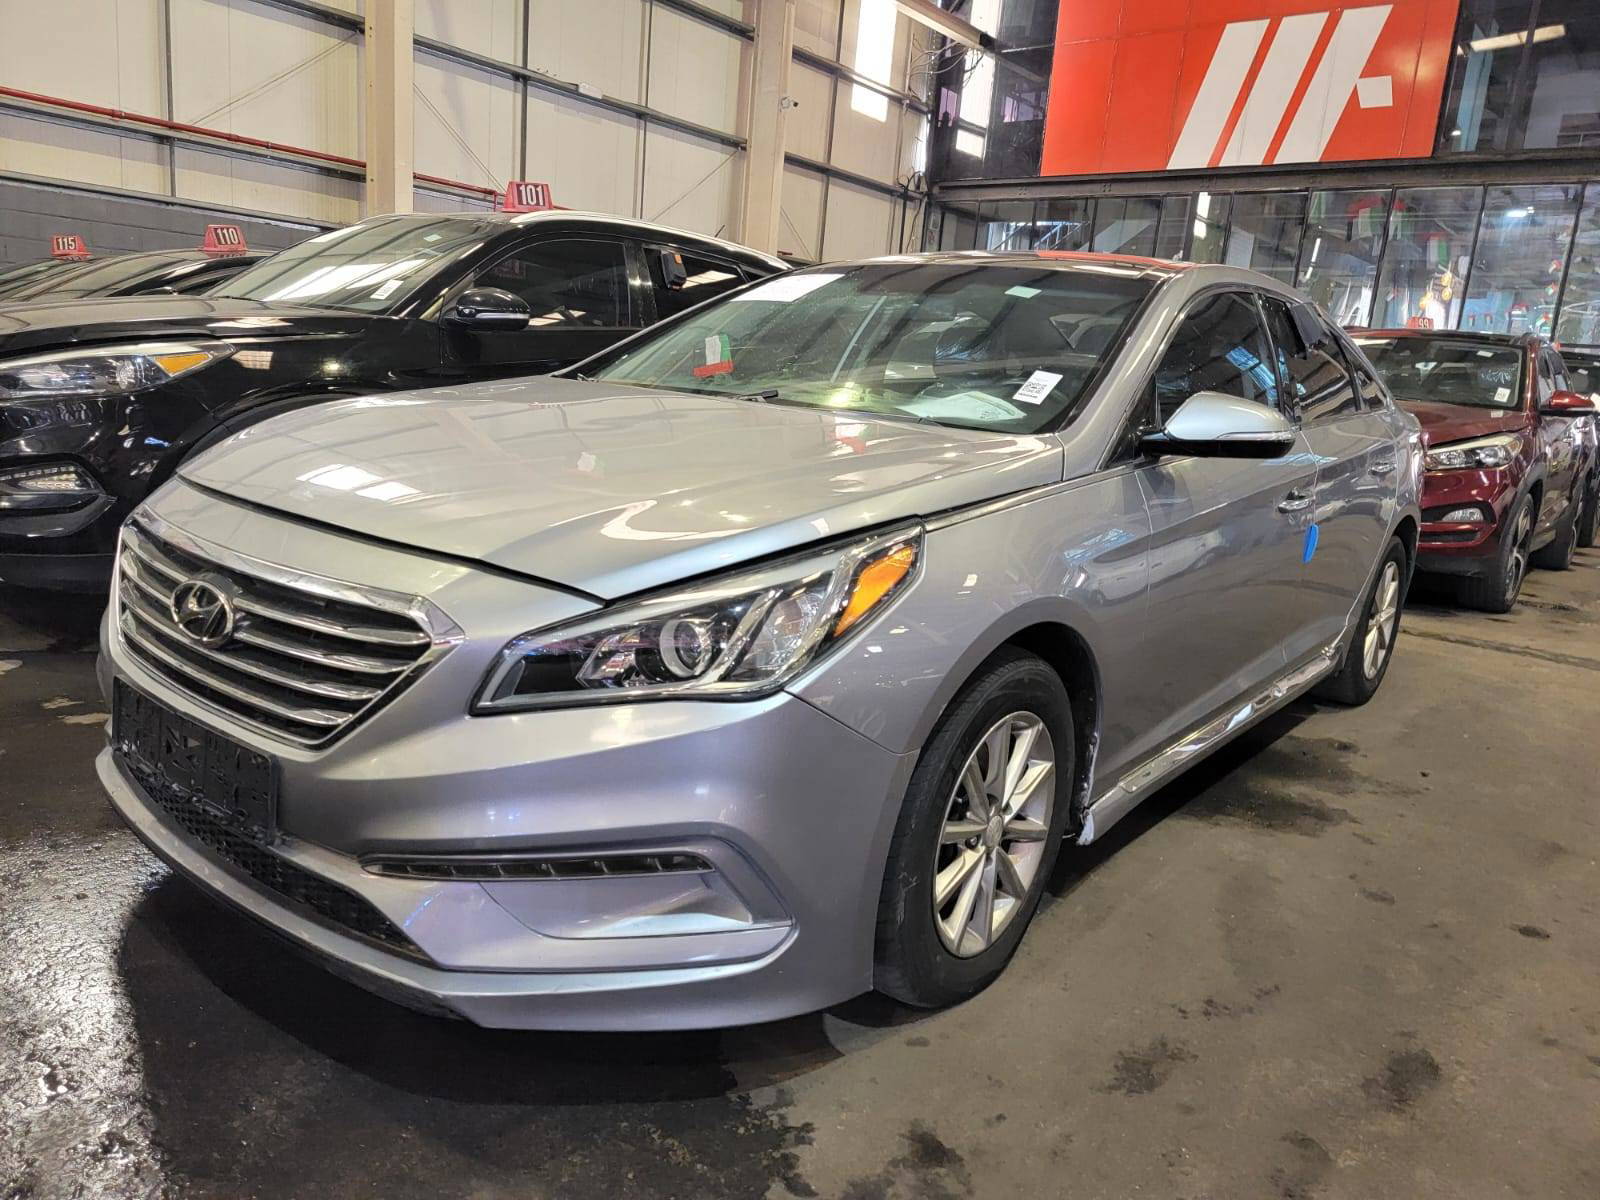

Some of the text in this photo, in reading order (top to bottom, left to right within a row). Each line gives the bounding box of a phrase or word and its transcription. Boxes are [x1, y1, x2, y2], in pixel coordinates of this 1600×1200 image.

[519, 184, 544, 206] 101
[57, 236, 76, 250] 115
[216, 227, 239, 245] 110
